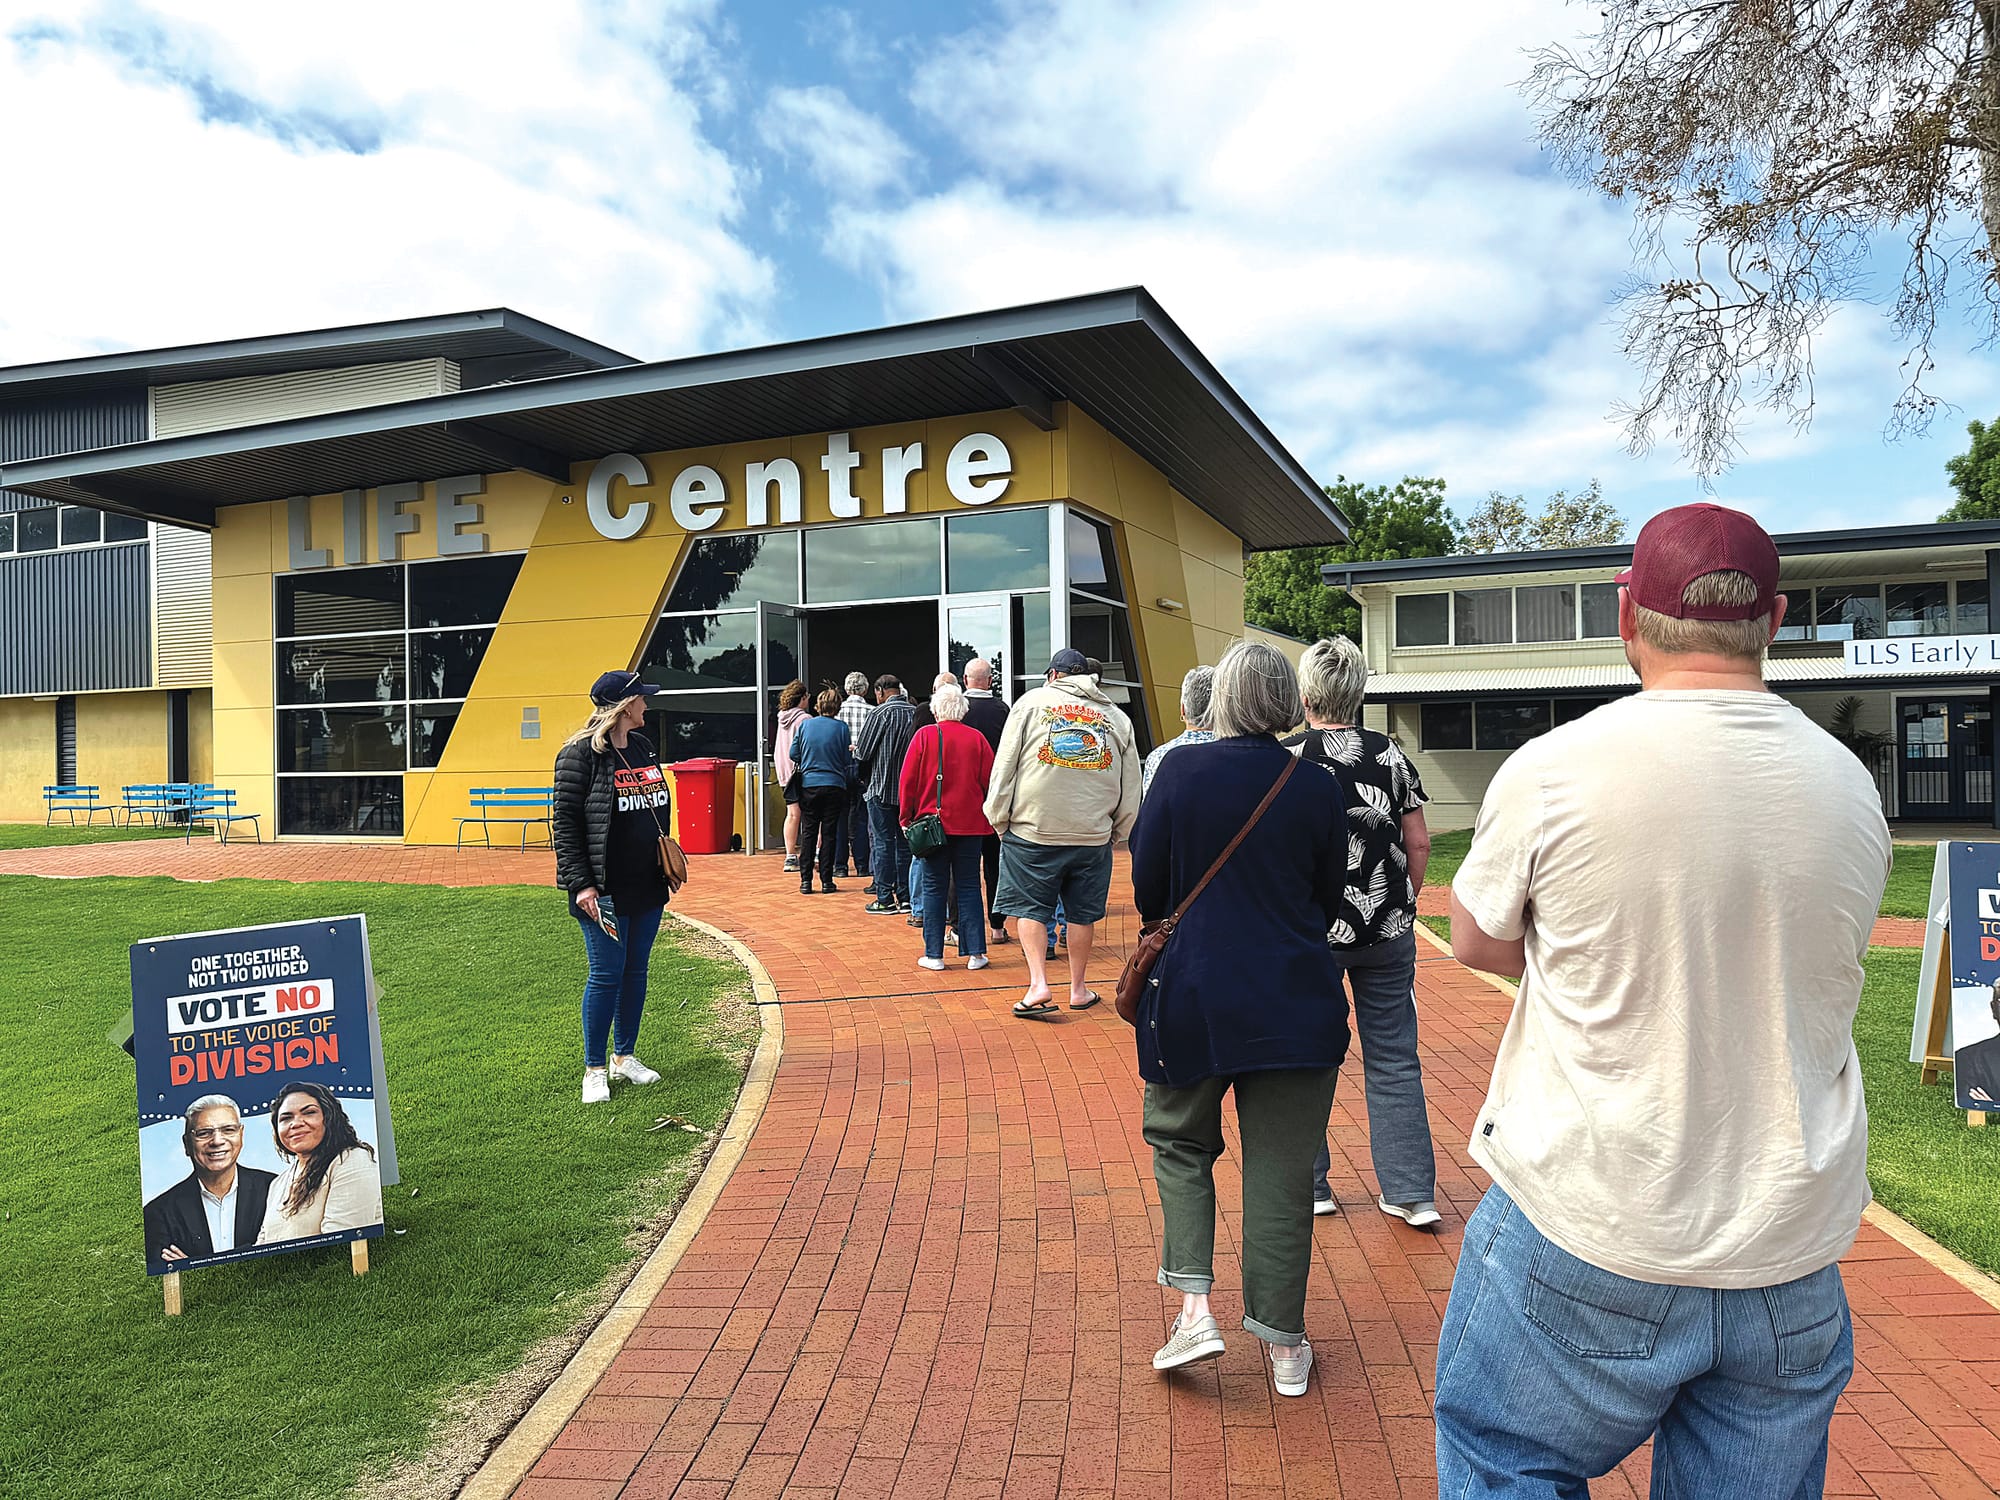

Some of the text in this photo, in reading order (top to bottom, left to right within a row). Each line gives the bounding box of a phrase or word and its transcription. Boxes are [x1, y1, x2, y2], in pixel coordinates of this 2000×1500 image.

[287, 432, 1015, 570] LIFE Centre
[1854, 643, 1900, 665] LLS
[1911, 639, 1979, 668] Early
[645, 767, 663, 780] NO
[617, 788, 629, 796] TO
[640, 783, 663, 796] OICE
[618, 790, 669, 812] DIVISIO
[191, 945, 305, 973] ONE TOGETHER,
[188, 959, 309, 989] NOT TWO DIVIDED
[178, 985, 321, 1026] VOTE NO
[169, 1015, 336, 1053] TO THE VOICE OF
[170, 1033, 339, 1087] DIVISION
